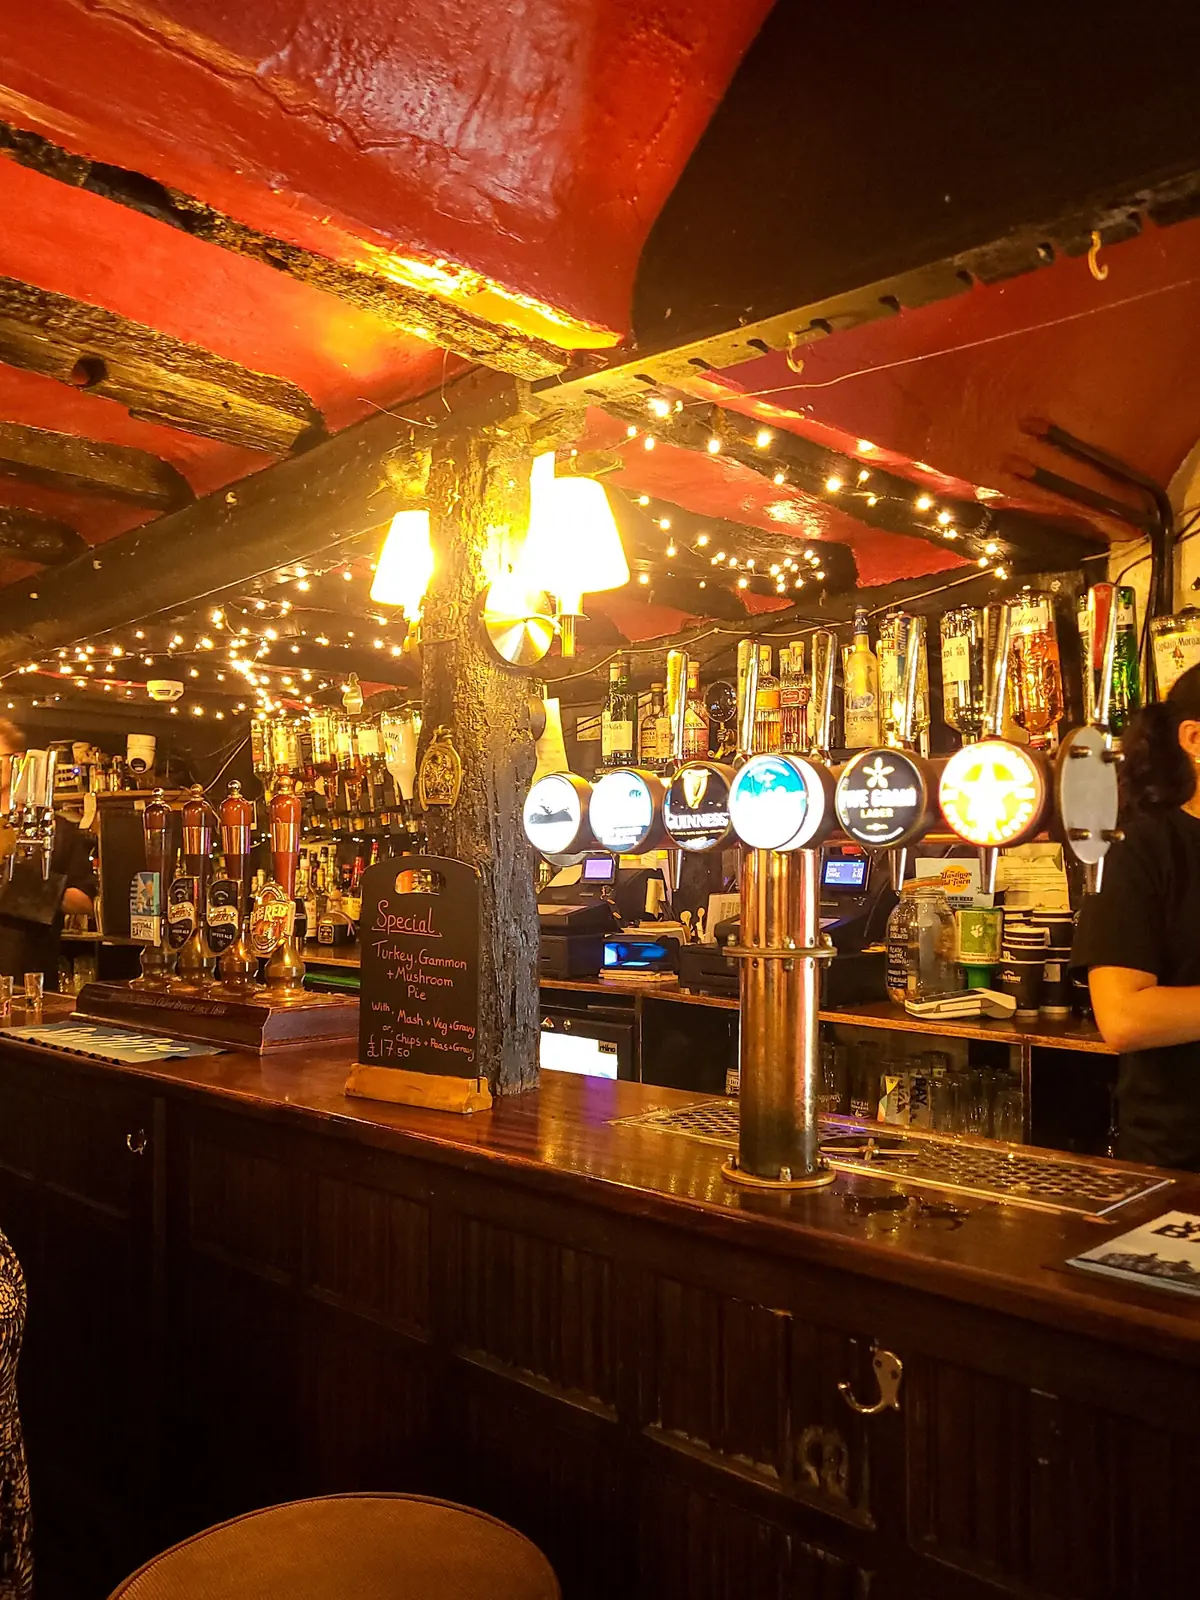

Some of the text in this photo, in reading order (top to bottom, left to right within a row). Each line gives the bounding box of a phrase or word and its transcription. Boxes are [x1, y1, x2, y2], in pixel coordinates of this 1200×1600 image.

[667, 813, 730, 830] GUINNESS
[861, 808, 893, 818] LAGER
[941, 869, 972, 880] Hastings
[376, 899, 435, 935] Special
[418, 948, 467, 970] Gammon
[407, 984, 427, 1001] Pie
[397, 1009, 424, 1026] Mash
[432, 1016, 448, 1036] Veg
[453, 1020, 476, 1040] Gravy
[453, 1042, 475, 1063] Gravy
